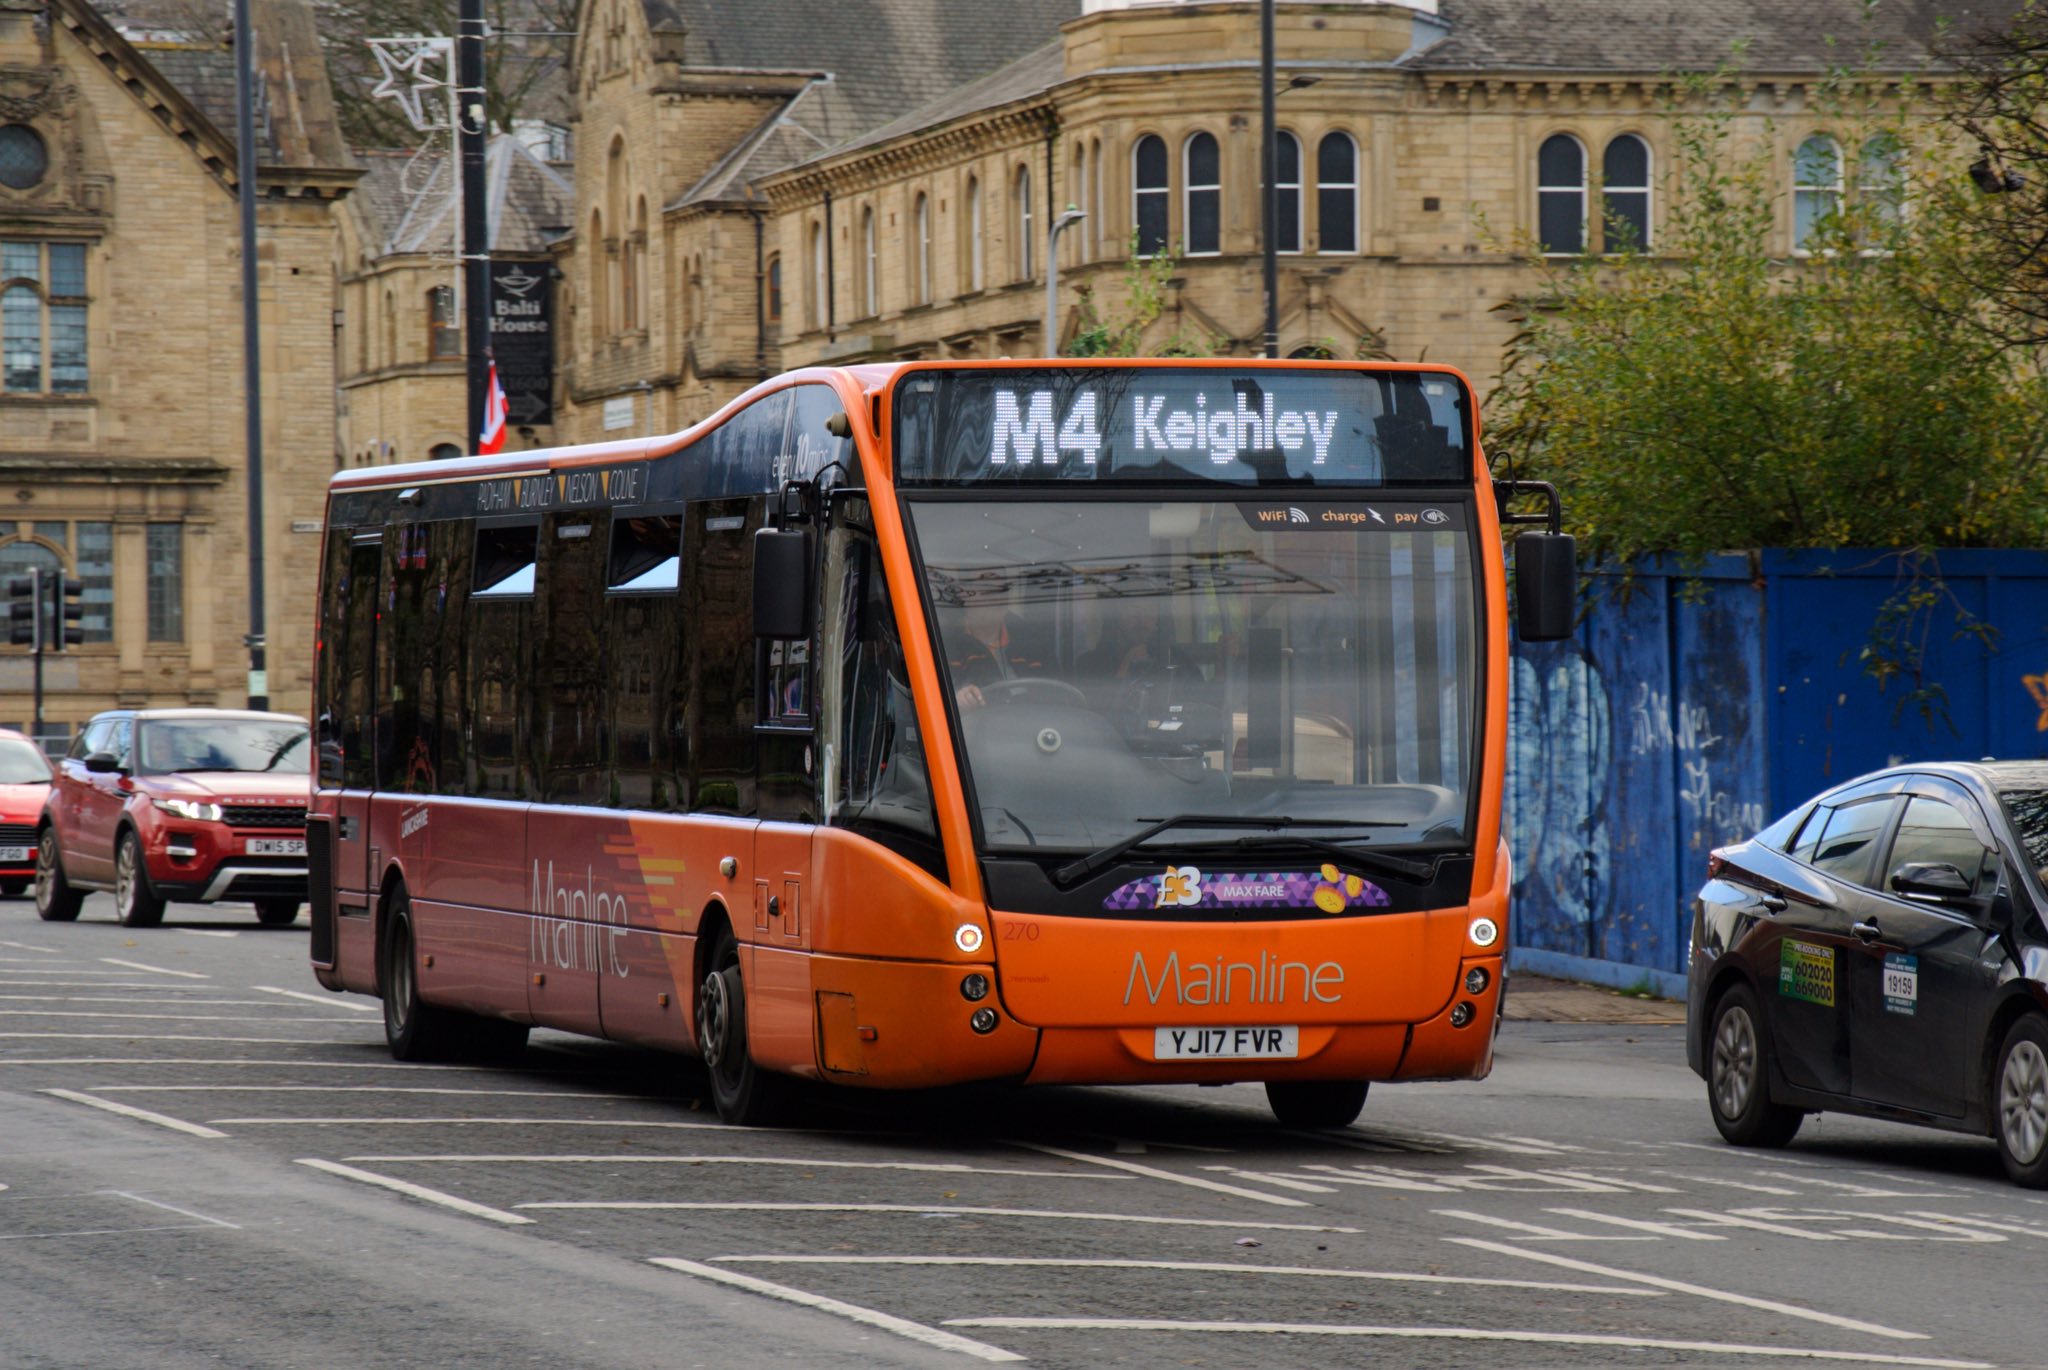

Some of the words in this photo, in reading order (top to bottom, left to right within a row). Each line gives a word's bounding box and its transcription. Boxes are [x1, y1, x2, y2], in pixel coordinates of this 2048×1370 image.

[495, 299, 541, 316] Balti
[488, 316, 549, 333] House
[991, 391, 1102, 465] M4
[1134, 392, 1338, 465] Keighley
[795, 433, 809, 475] 10
[521, 476, 557, 508] BURNLEY
[566, 471, 599, 504] NELSON
[609, 468, 639, 501] COLNE
[1258, 511, 1287, 522] WiFi
[1321, 510, 1366, 524] charge
[1394, 512, 1418, 524] pay
[255, 841, 284, 853] DW15
[1157, 866, 1202, 907] £3
[1223, 885, 1254, 897] MAX
[1255, 885, 1285, 897] FARE
[531, 858, 629, 979] Mainline
[1003, 921, 1040, 942] 270
[1124, 949, 1345, 1005] Mainline
[1795, 961, 1833, 983] 602020
[1794, 981, 1833, 1001] 669000
[1888, 974, 1913, 996] 19159
[1171, 1030, 1227, 1054] YJ17
[1234, 1029, 1283, 1053] FVR
